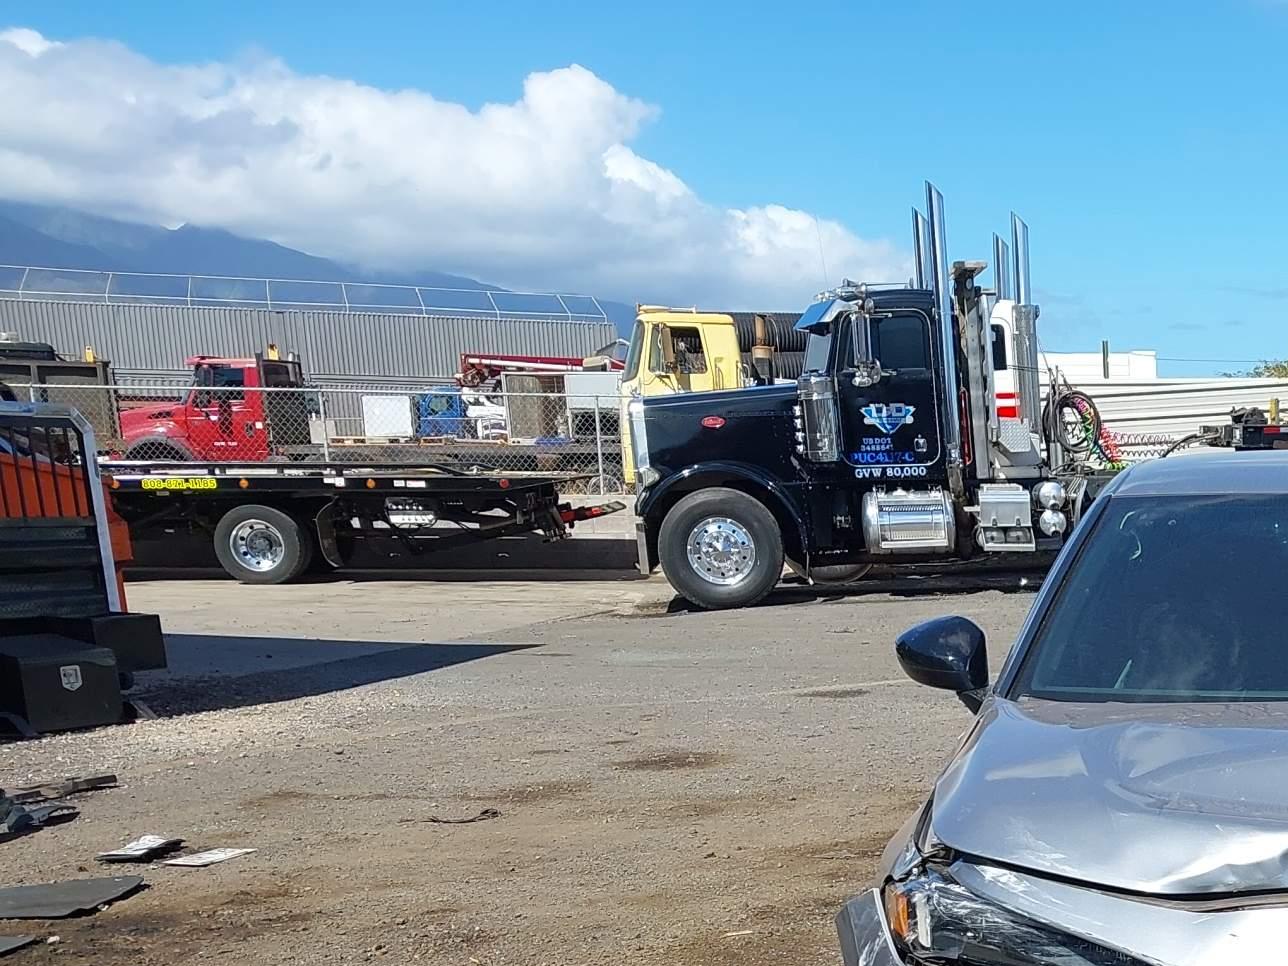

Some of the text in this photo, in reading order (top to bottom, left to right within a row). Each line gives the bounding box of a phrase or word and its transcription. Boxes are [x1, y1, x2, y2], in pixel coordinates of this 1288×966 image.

[855, 467, 926, 478] GVW 80,000
[142, 479, 216, 489] 808-871-1185
